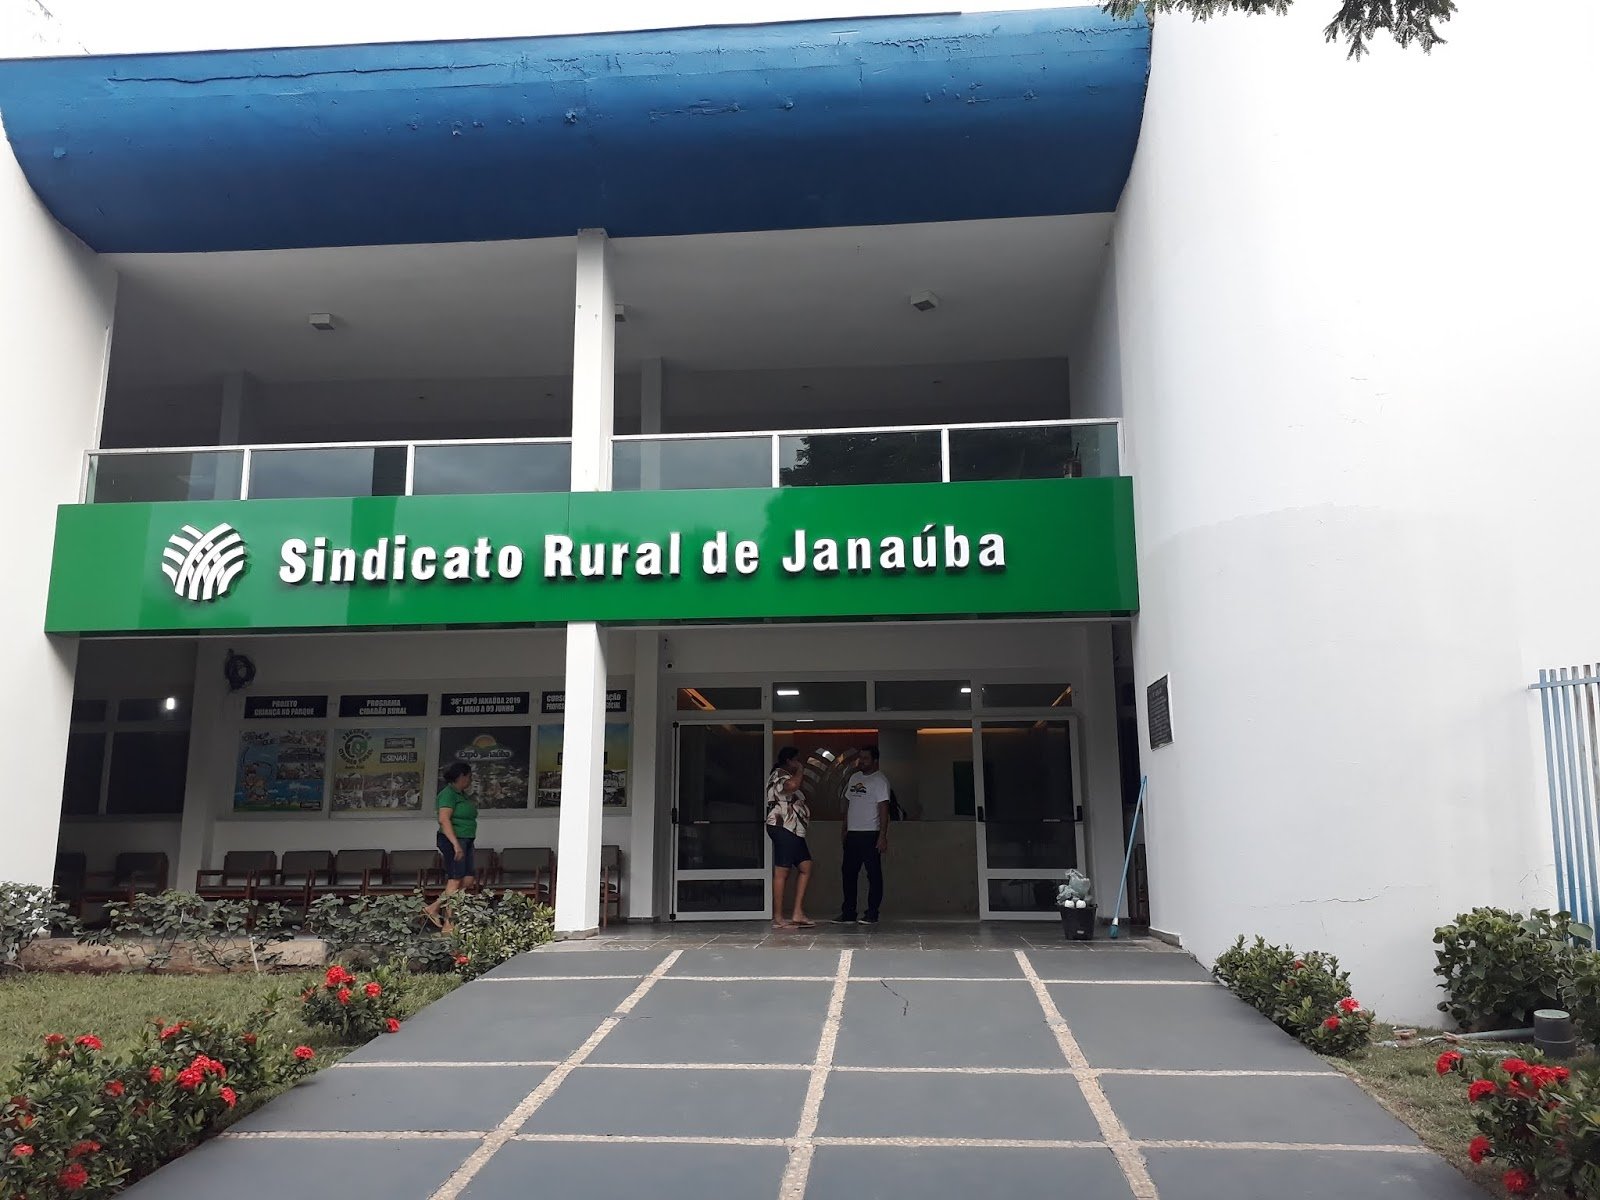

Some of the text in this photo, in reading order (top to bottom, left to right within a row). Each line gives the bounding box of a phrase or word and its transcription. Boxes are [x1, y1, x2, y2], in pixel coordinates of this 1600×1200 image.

[279, 525, 1007, 584] Sindicato Rural de Janaúba
[272, 700, 298, 708] PROJETO
[366, 699, 401, 707] PROGRAMA
[478, 695, 505, 705] JANAÚBA
[505, 696, 521, 704] 2019
[254, 707, 314, 717] CRIANÇA NO PARQUE
[359, 706, 407, 715] CIDADÃO RURAL
[456, 705, 464, 714] 31
[464, 705, 480, 713] MAIO
[480, 705, 486, 713] A
[495, 704, 515, 713] JUNHO
